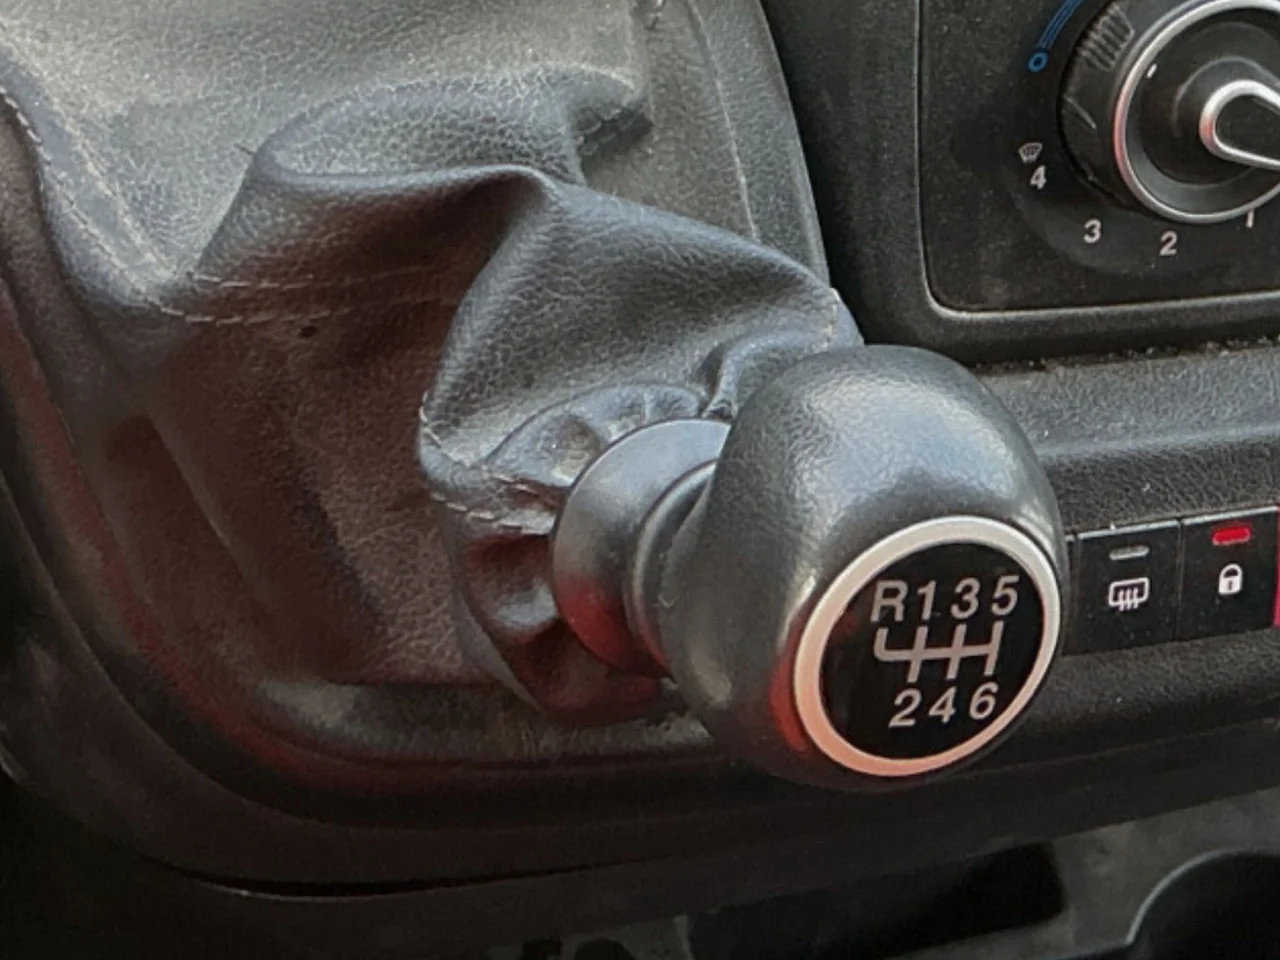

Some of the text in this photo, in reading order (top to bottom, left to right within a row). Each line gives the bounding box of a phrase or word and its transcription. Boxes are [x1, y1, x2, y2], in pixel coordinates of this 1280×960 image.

[1030, 165, 1047, 189] 4
[1083, 218, 1102, 244] 3
[1158, 230, 1178, 257] 2
